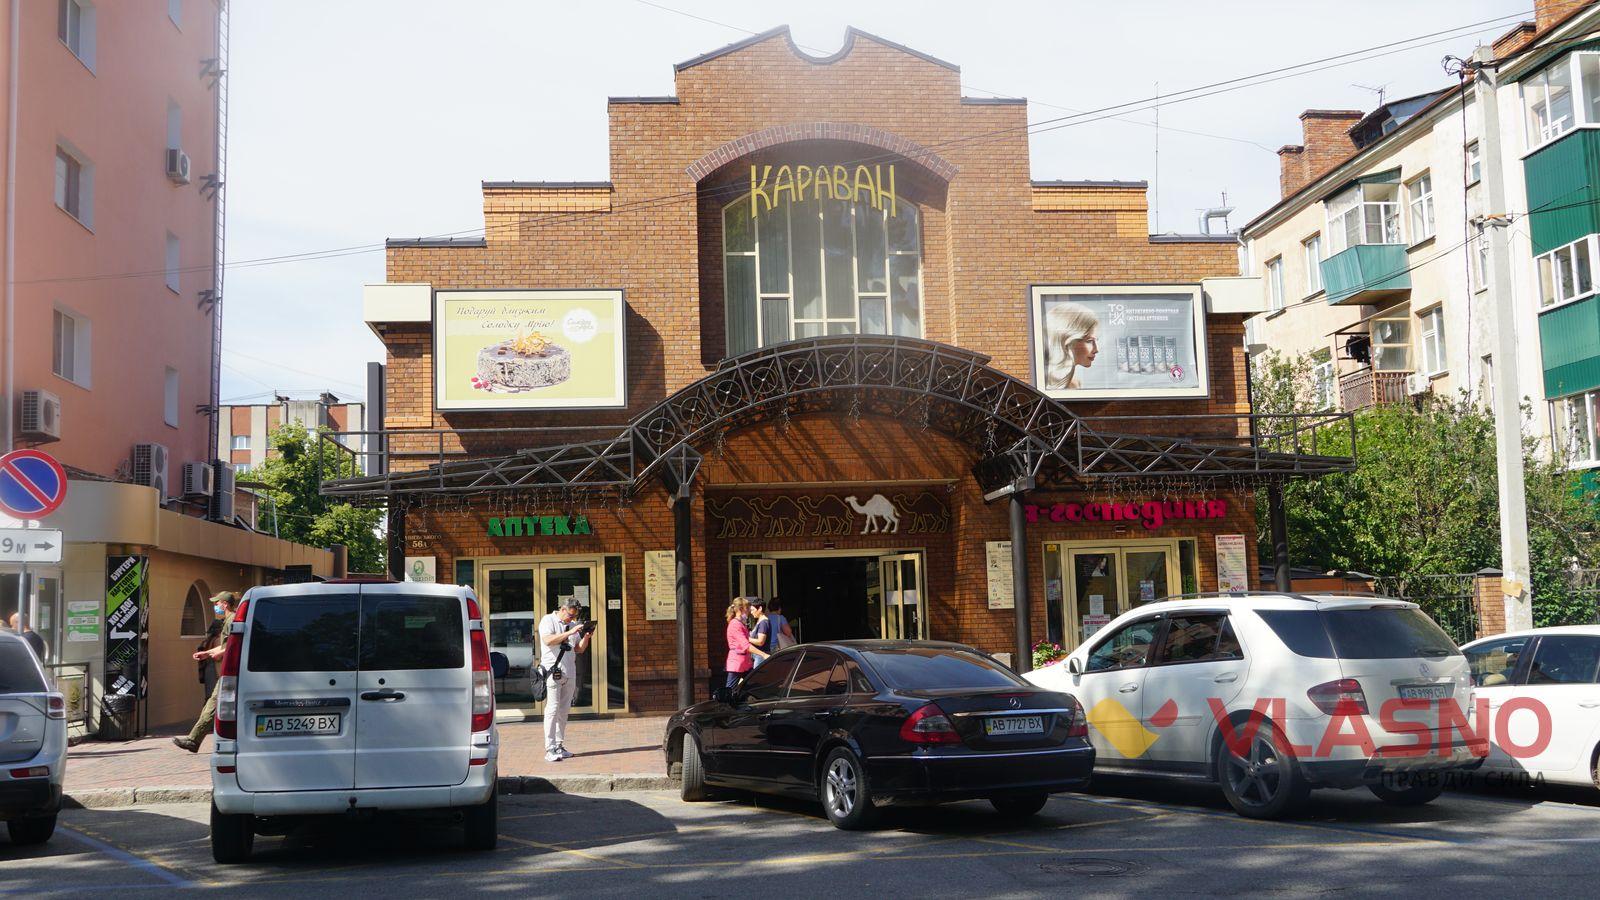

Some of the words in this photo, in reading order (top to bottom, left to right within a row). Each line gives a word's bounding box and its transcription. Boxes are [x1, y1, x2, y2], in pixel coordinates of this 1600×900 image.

[750, 164, 897, 219] КАРАВАН
[456, 306, 496, 319] Подаруй
[481, 320, 521, 331] Солодку
[487, 514, 592, 537] АПТЕКА
[110, 556, 136, 581] БУРГЕРИ
[121, 582, 138, 597] FREE
[107, 597, 134, 626] ХОТ-ДОГ
[265, 719, 284, 731] AB
[286, 718, 316, 730] 5249
[318, 716, 336, 730] BX
[992, 720, 1006, 731] AB
[1006, 718, 1027, 730] 7727
[1028, 717, 1042, 729] BX
